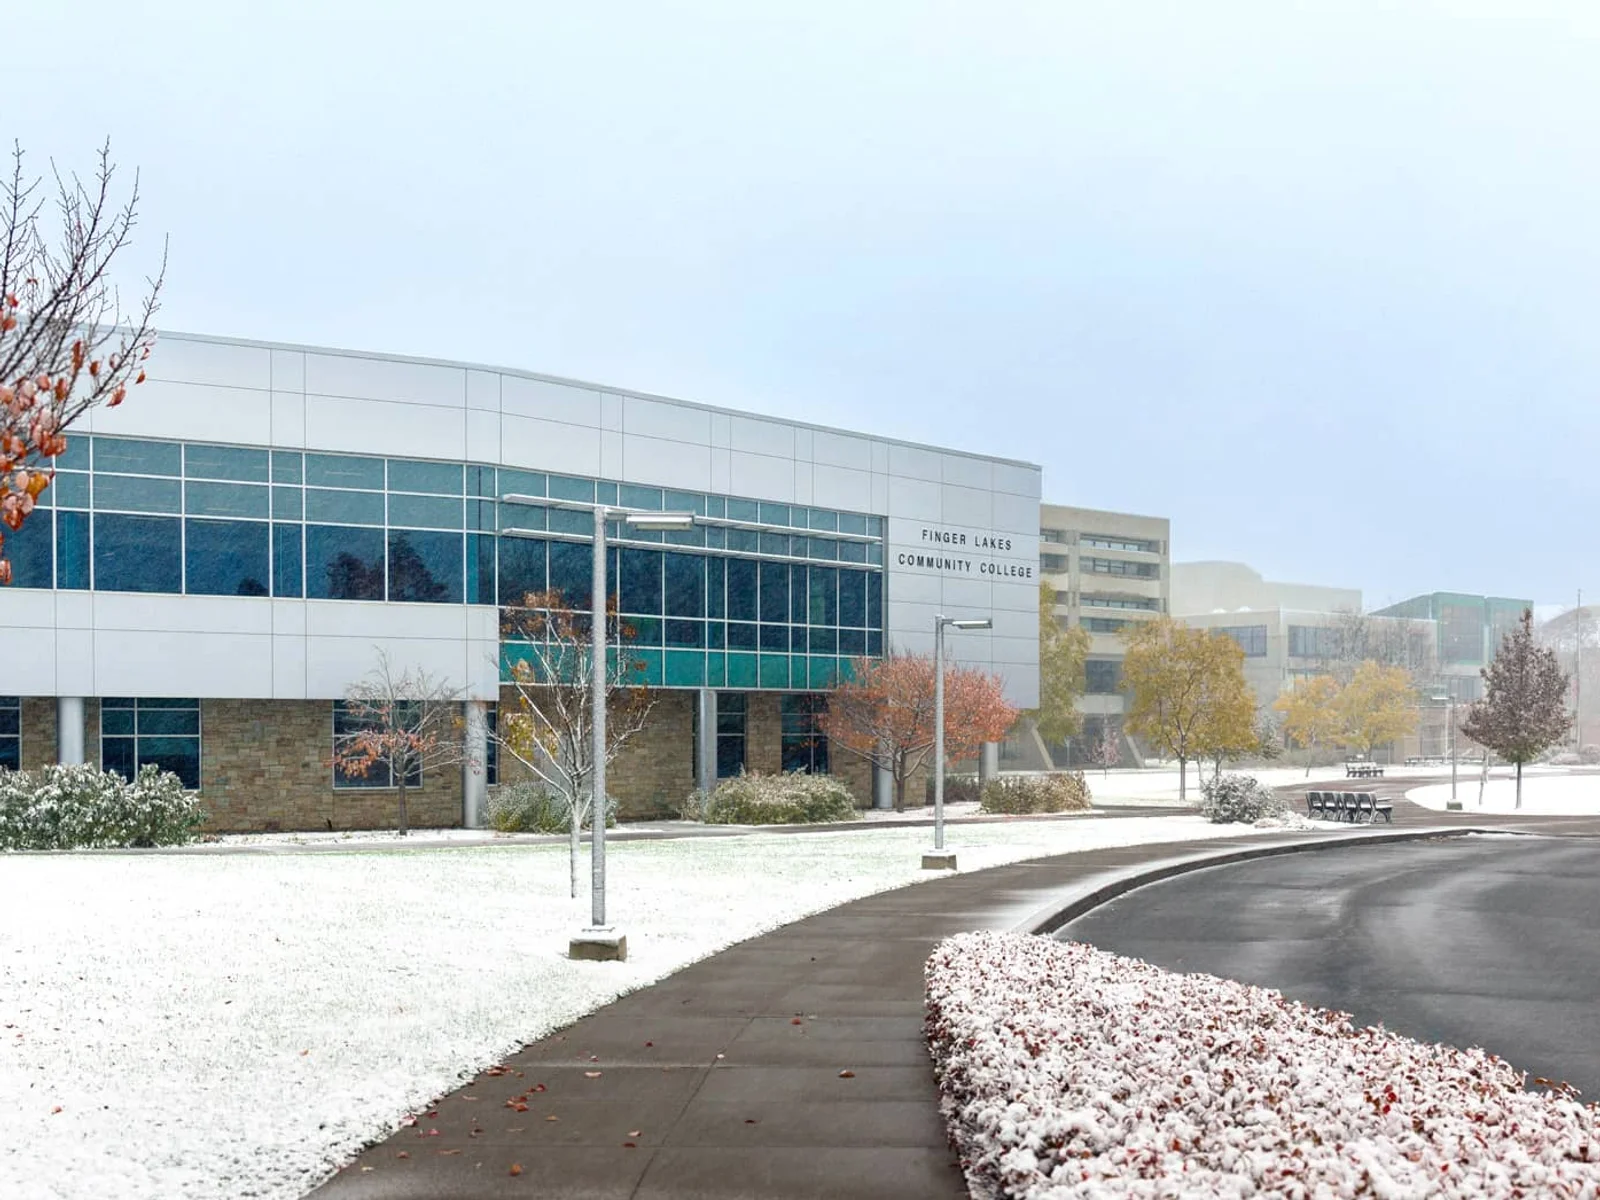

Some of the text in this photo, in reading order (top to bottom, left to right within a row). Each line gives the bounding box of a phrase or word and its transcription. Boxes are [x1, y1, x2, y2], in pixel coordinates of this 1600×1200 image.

[922, 529, 1012, 550] FINGER LAKES
[899, 553, 1032, 578] COMMUNITY COLLEGE
